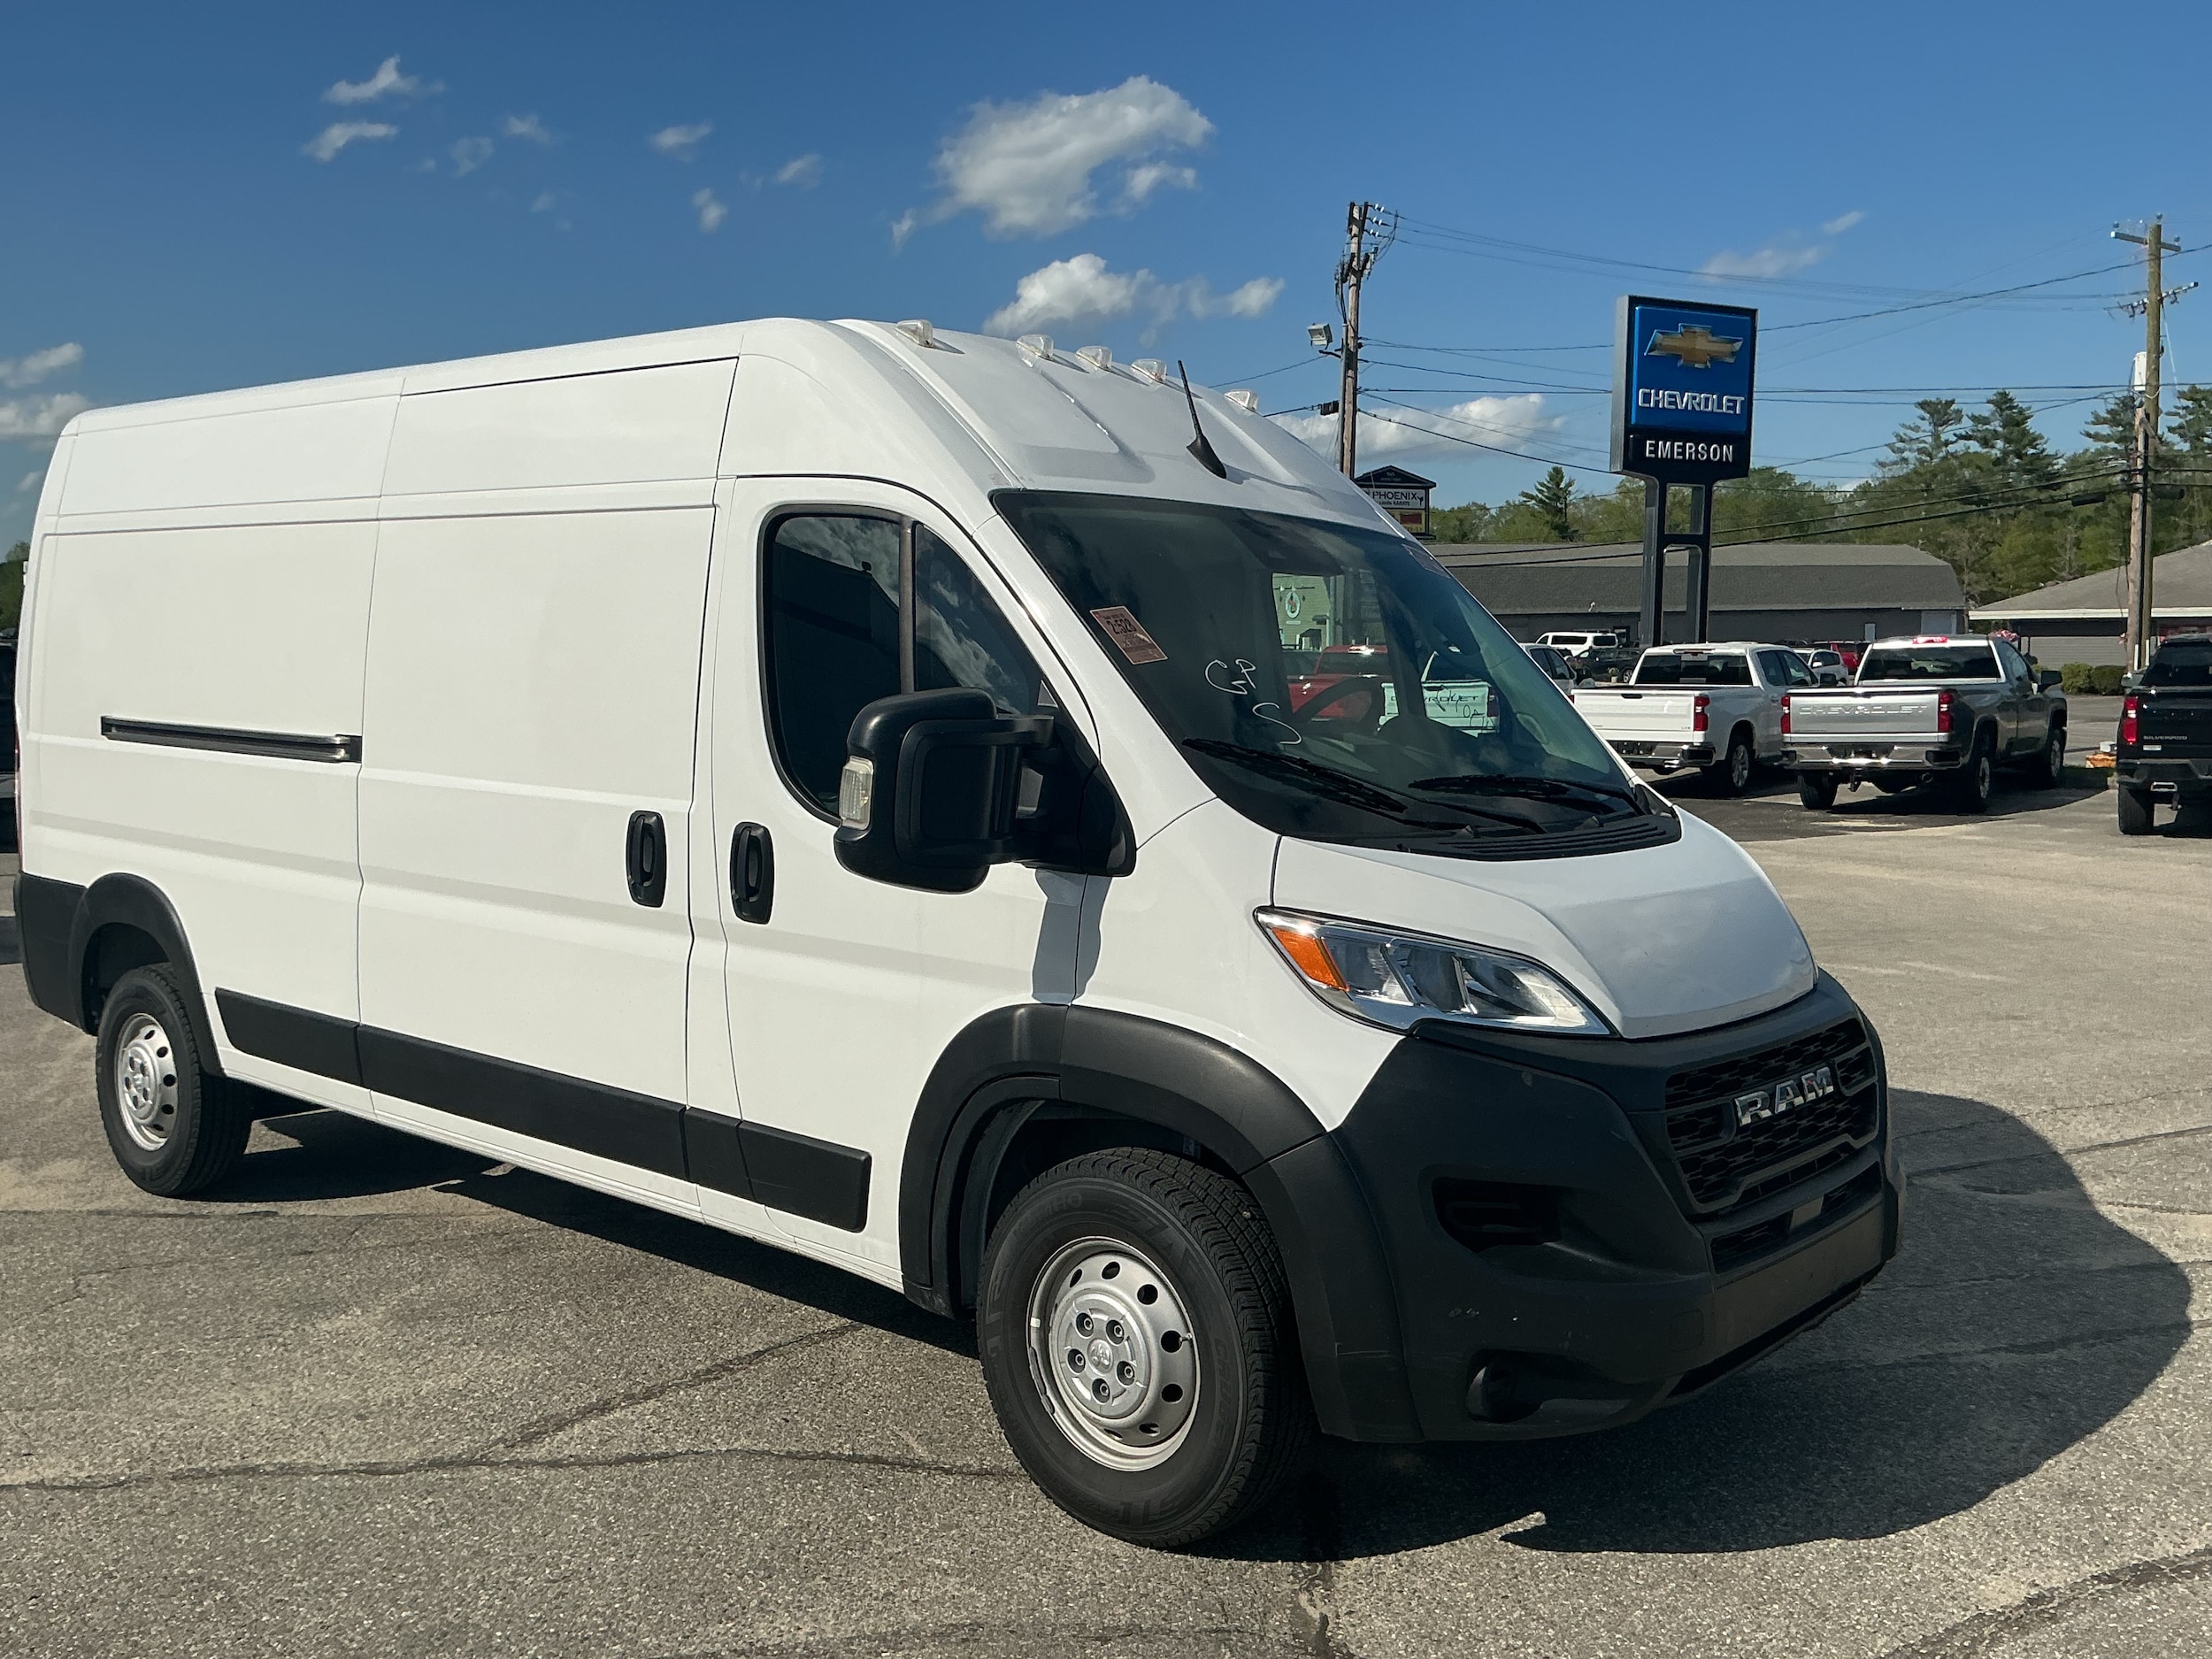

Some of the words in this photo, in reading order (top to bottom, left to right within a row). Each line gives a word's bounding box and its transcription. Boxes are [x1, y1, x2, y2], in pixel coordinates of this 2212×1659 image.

[1638, 388, 1745, 415] CHEVROLET
[1645, 440, 1734, 463] EMERSON
[1372, 491, 1417, 501] PHOENIX
[1799, 705, 1928, 715] CHEVROLET
[1734, 1066, 1834, 1127] RAM
